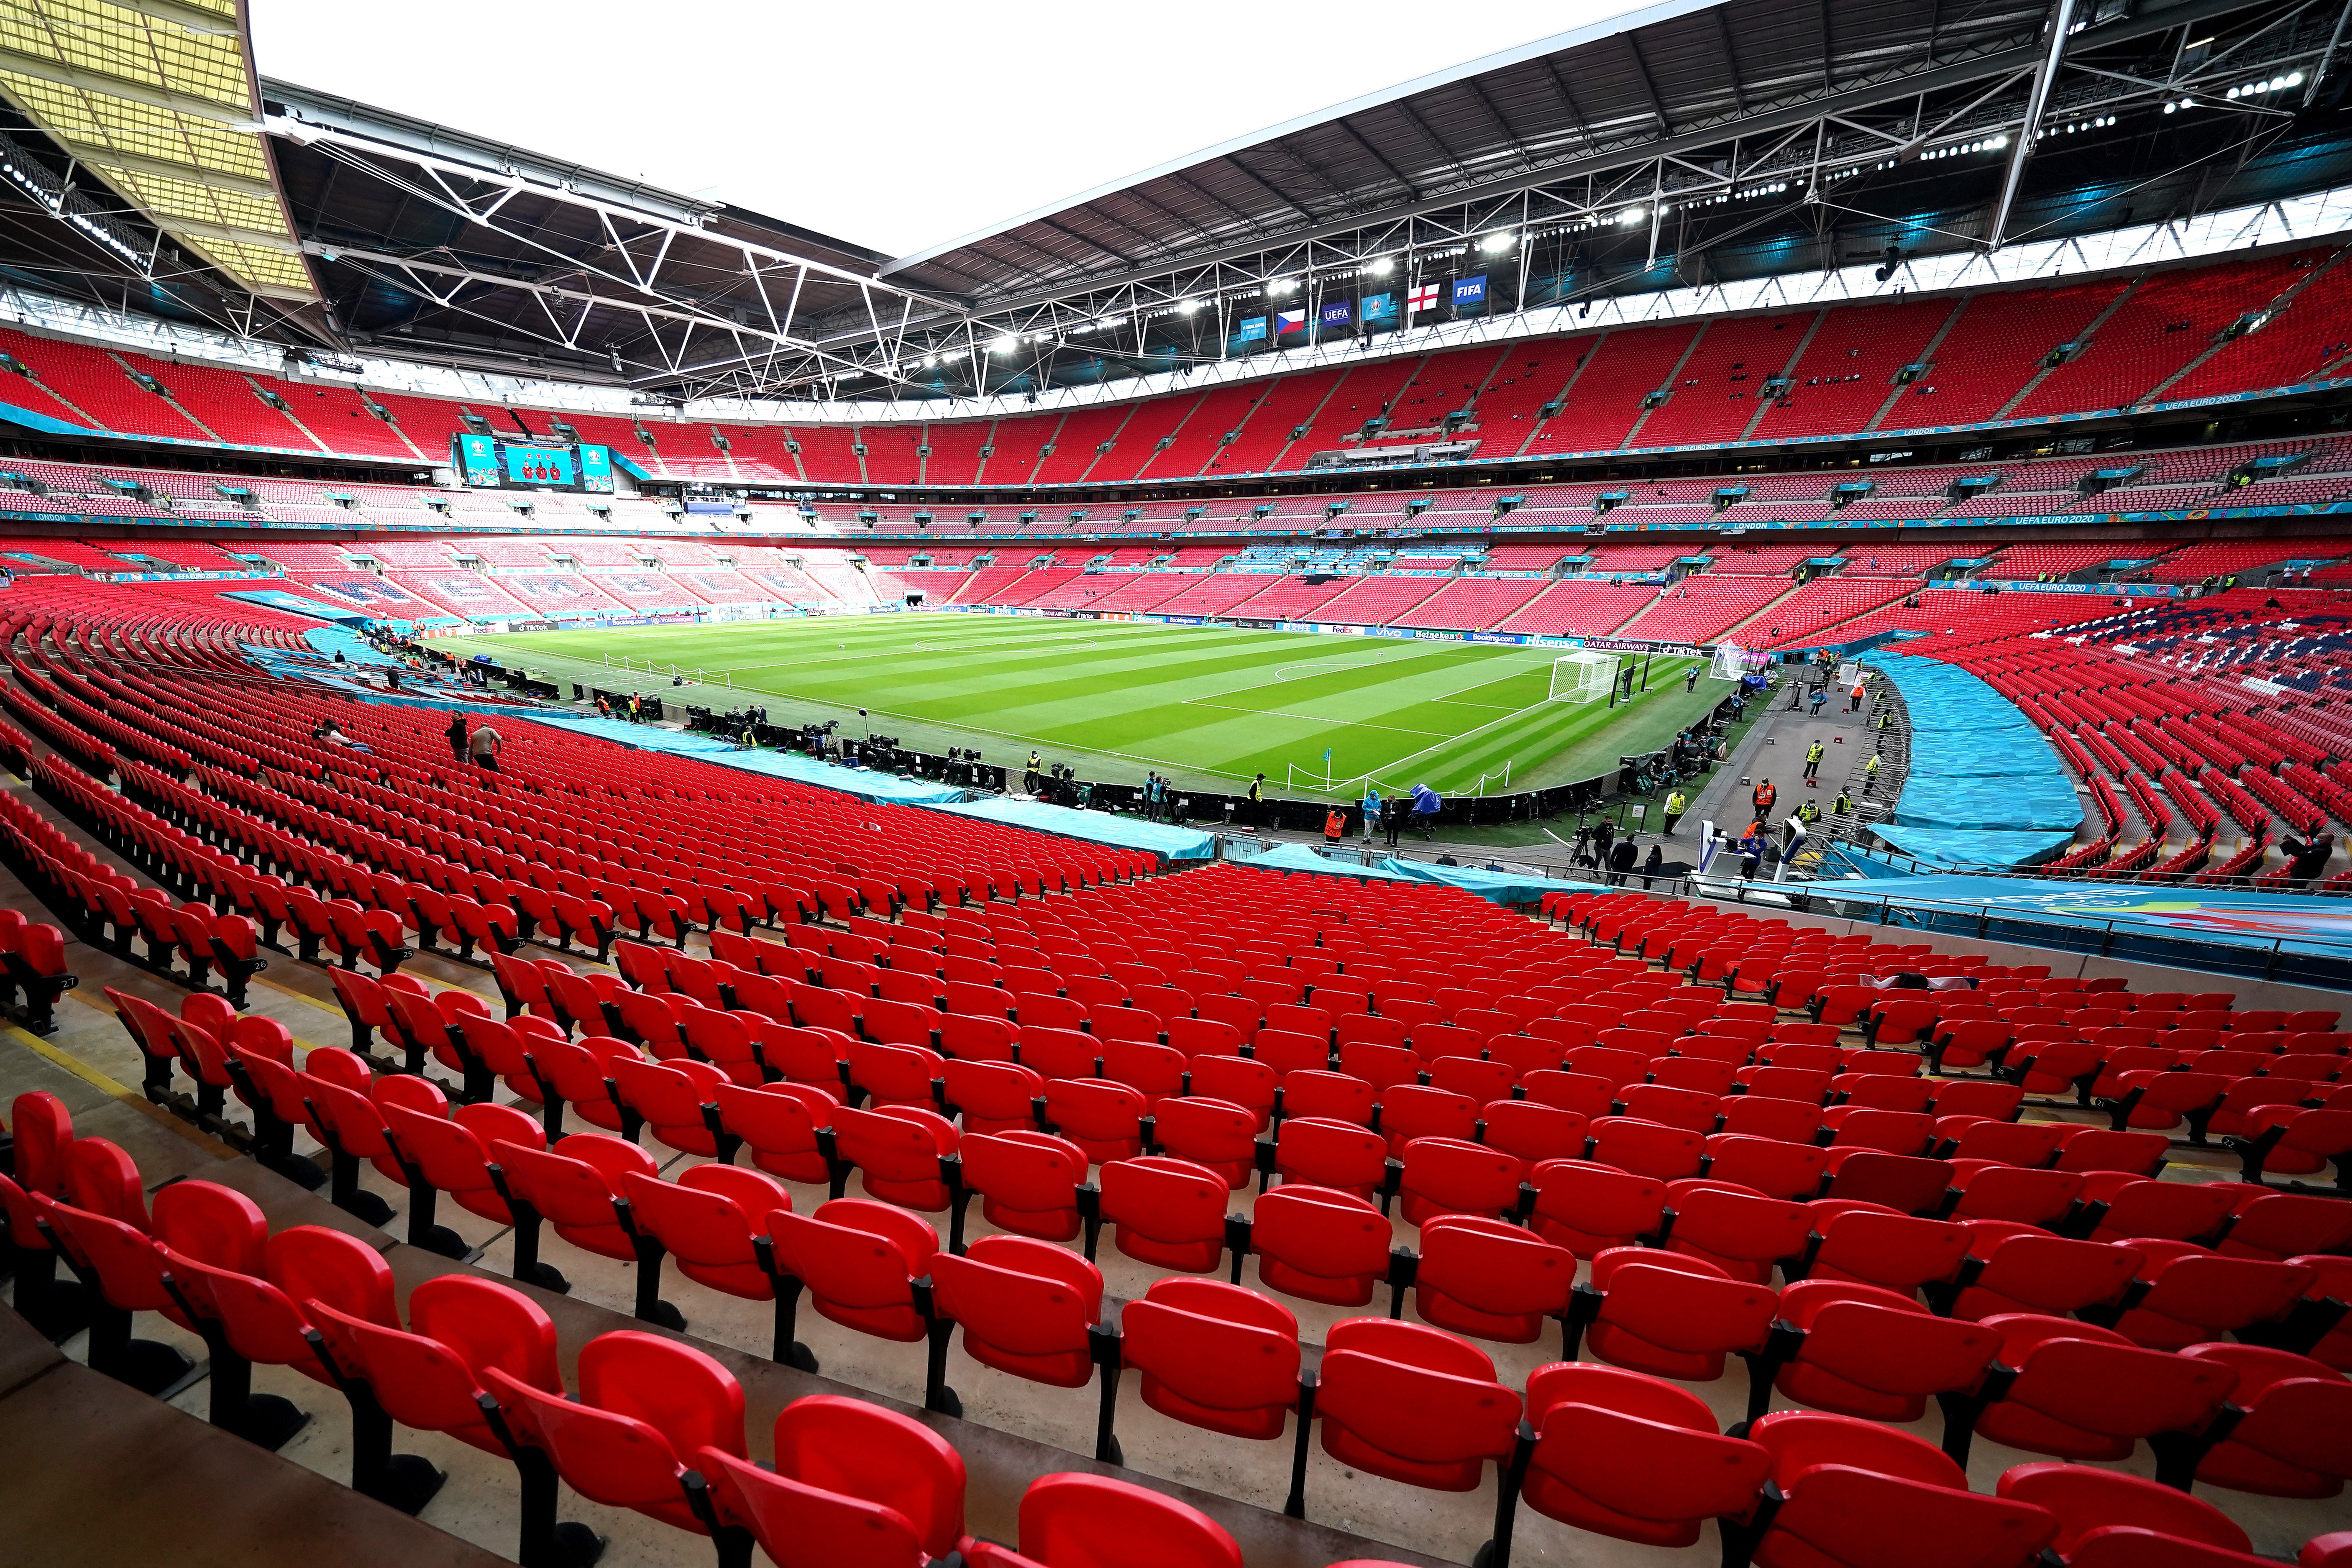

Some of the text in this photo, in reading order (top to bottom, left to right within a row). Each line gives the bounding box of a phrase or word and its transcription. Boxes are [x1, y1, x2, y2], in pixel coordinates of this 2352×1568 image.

[1457, 284, 1481, 297] FIFA
[1325, 309, 1349, 320] UEFA
[2190, 398, 2215, 407] EURO
[2216, 394, 2241, 404] 2020
[1415, 631, 1454, 640] Heineken
[1472, 634, 1515, 642] Booking.com
[1526, 636, 1579, 647] Hisense
[1583, 640, 1649, 651] QATAR AIRWAYS
